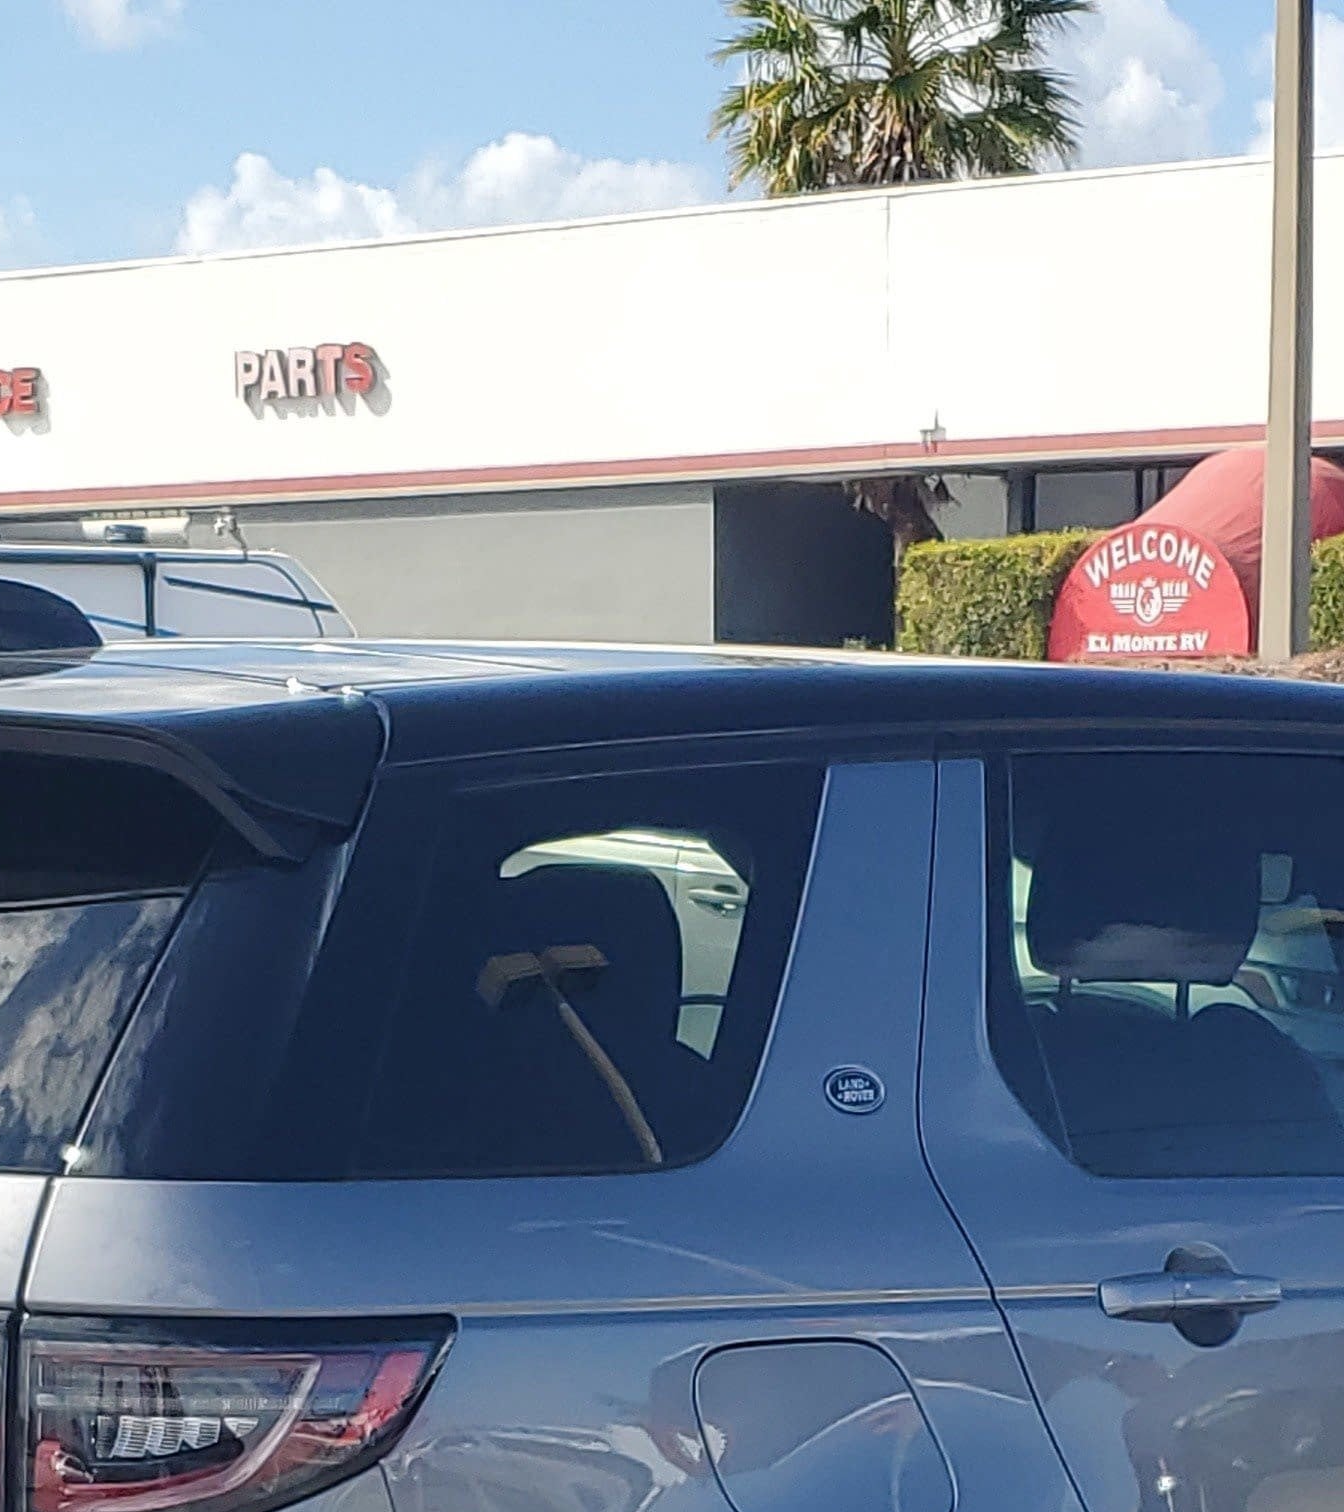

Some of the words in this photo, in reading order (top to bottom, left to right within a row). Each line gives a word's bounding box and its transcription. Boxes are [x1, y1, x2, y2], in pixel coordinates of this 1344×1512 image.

[235, 342, 377, 400] PARTS
[1084, 529, 1216, 590] WELCOME
[1087, 635, 1111, 653] EL
[1112, 634, 1178, 652] MONTE
[1179, 629, 1209, 651] RV
